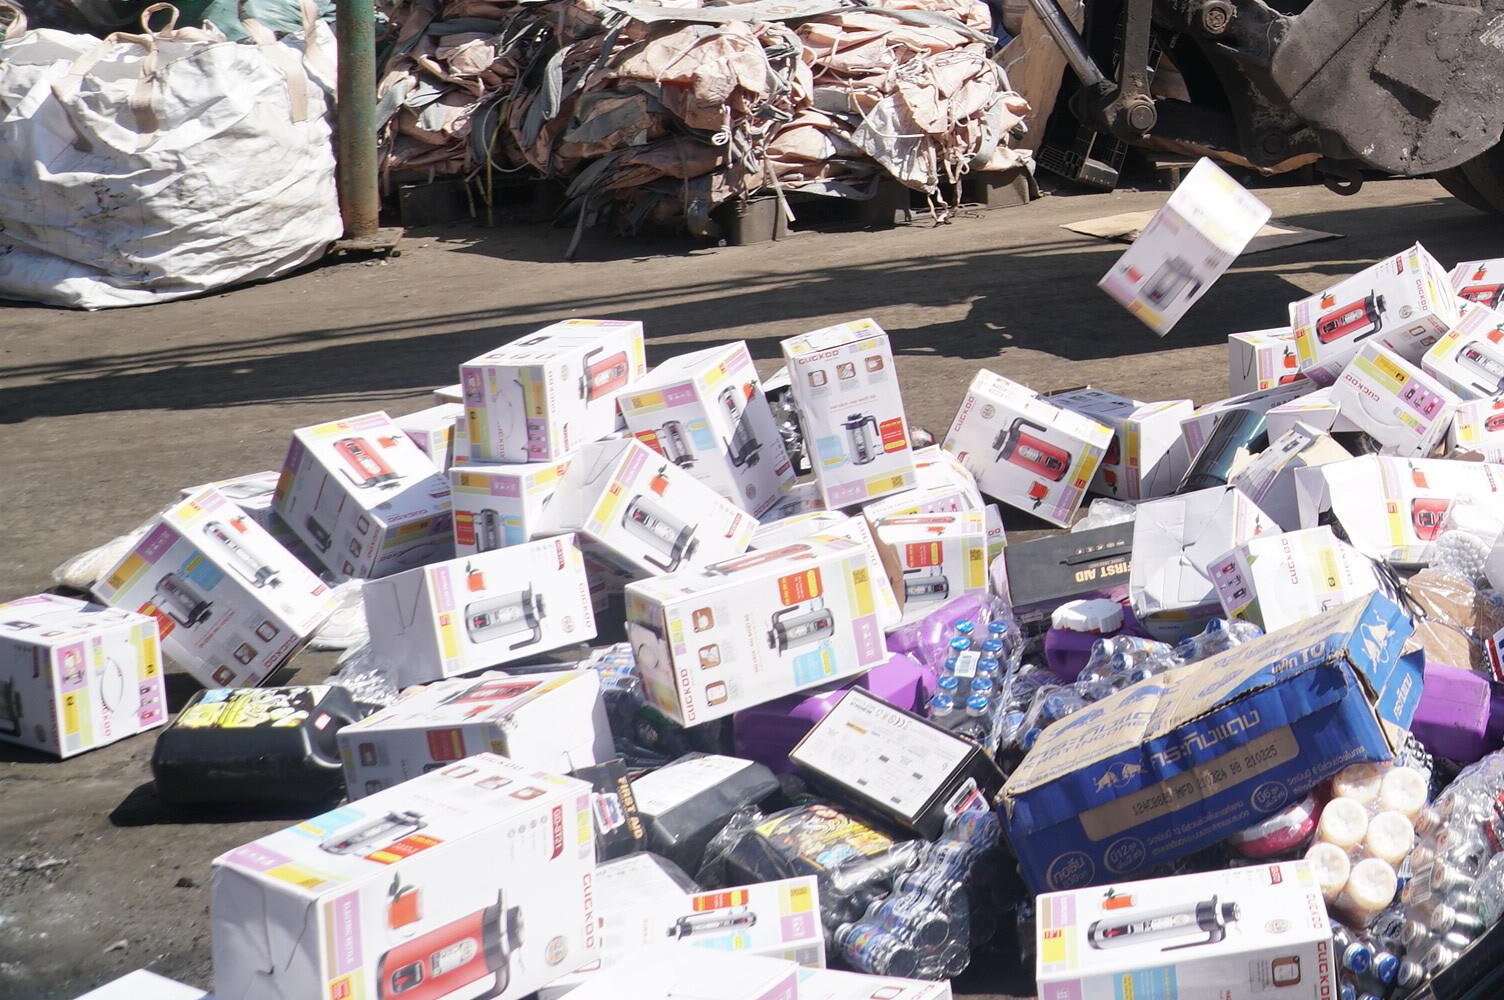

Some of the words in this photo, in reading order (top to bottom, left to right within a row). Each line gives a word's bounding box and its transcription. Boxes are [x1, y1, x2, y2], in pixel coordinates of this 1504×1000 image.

[1416, 279, 1429, 312] CUCKOO
[799, 349, 840, 366] CUCKOO
[1344, 373, 1381, 404] CUCKOO
[954, 395, 975, 433] CUCKOO
[1075, 567, 1096, 583] AID
[1100, 562, 1133, 579] FIRST
[1280, 537, 1299, 585] CUCKOO
[680, 667, 696, 722] CUCKOO
[617, 775, 638, 813] FIRST
[626, 812, 645, 841] AID
[583, 873, 595, 949] CUCKOO
